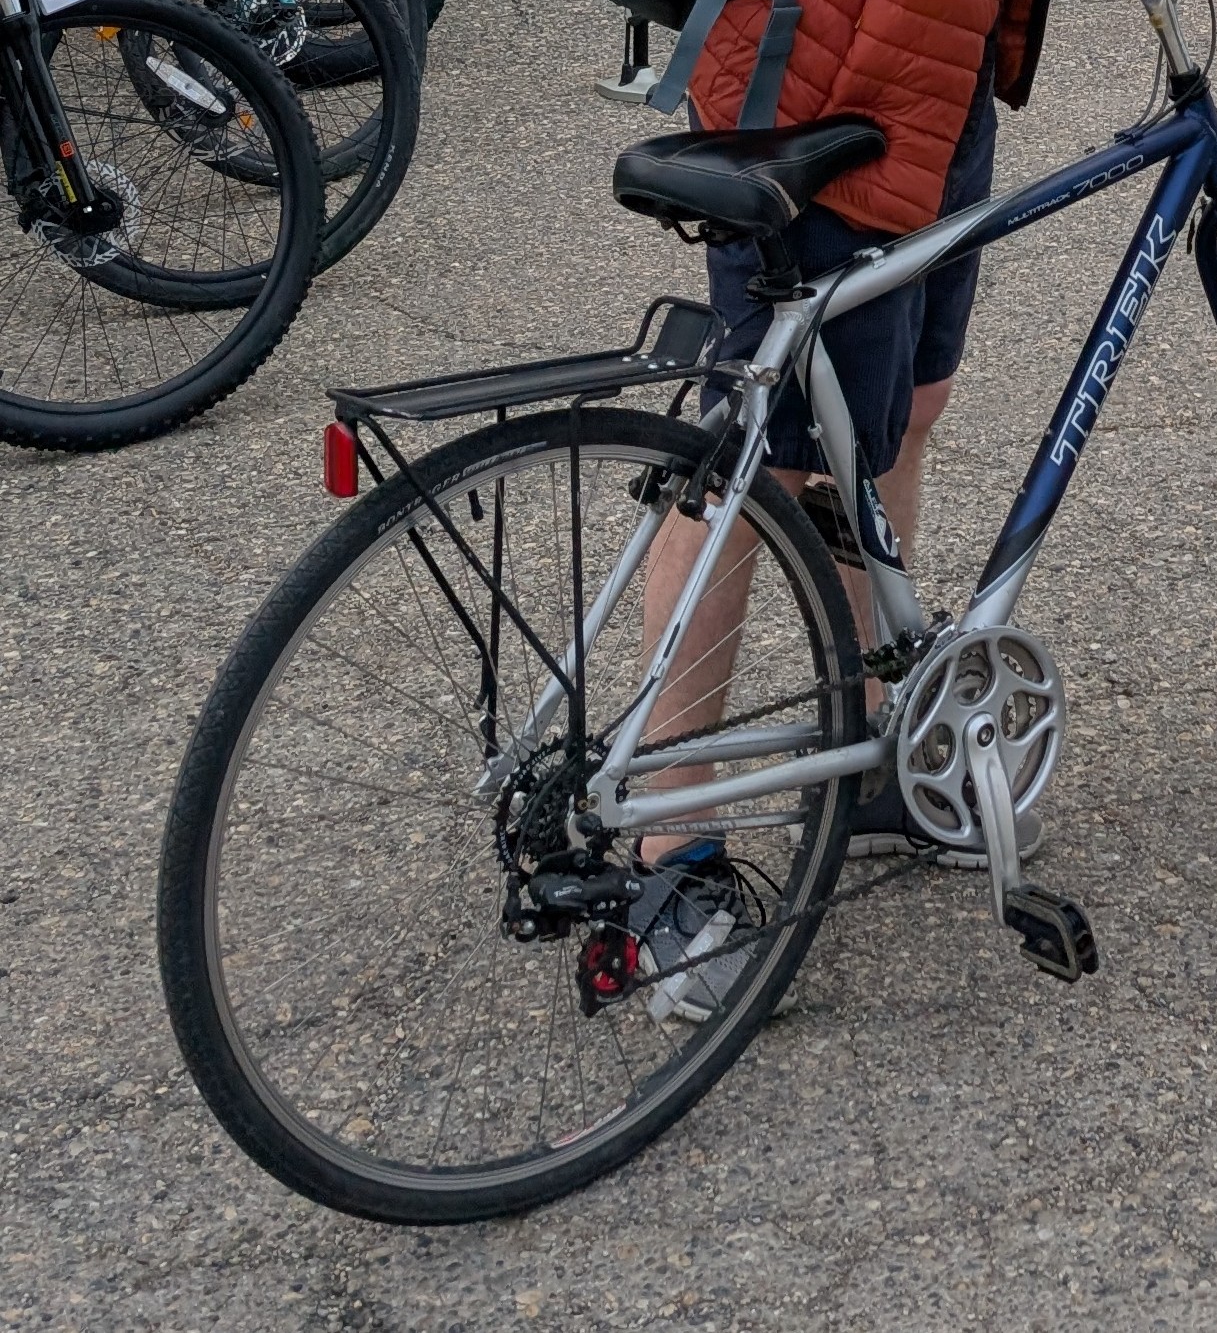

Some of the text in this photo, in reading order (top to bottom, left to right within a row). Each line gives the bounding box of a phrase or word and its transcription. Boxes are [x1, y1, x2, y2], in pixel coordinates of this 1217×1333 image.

[1007, 154, 1144, 227] MULTITRACK 7000
[1050, 213, 1177, 466] TREK
[377, 471, 461, 535] BONTRGER
